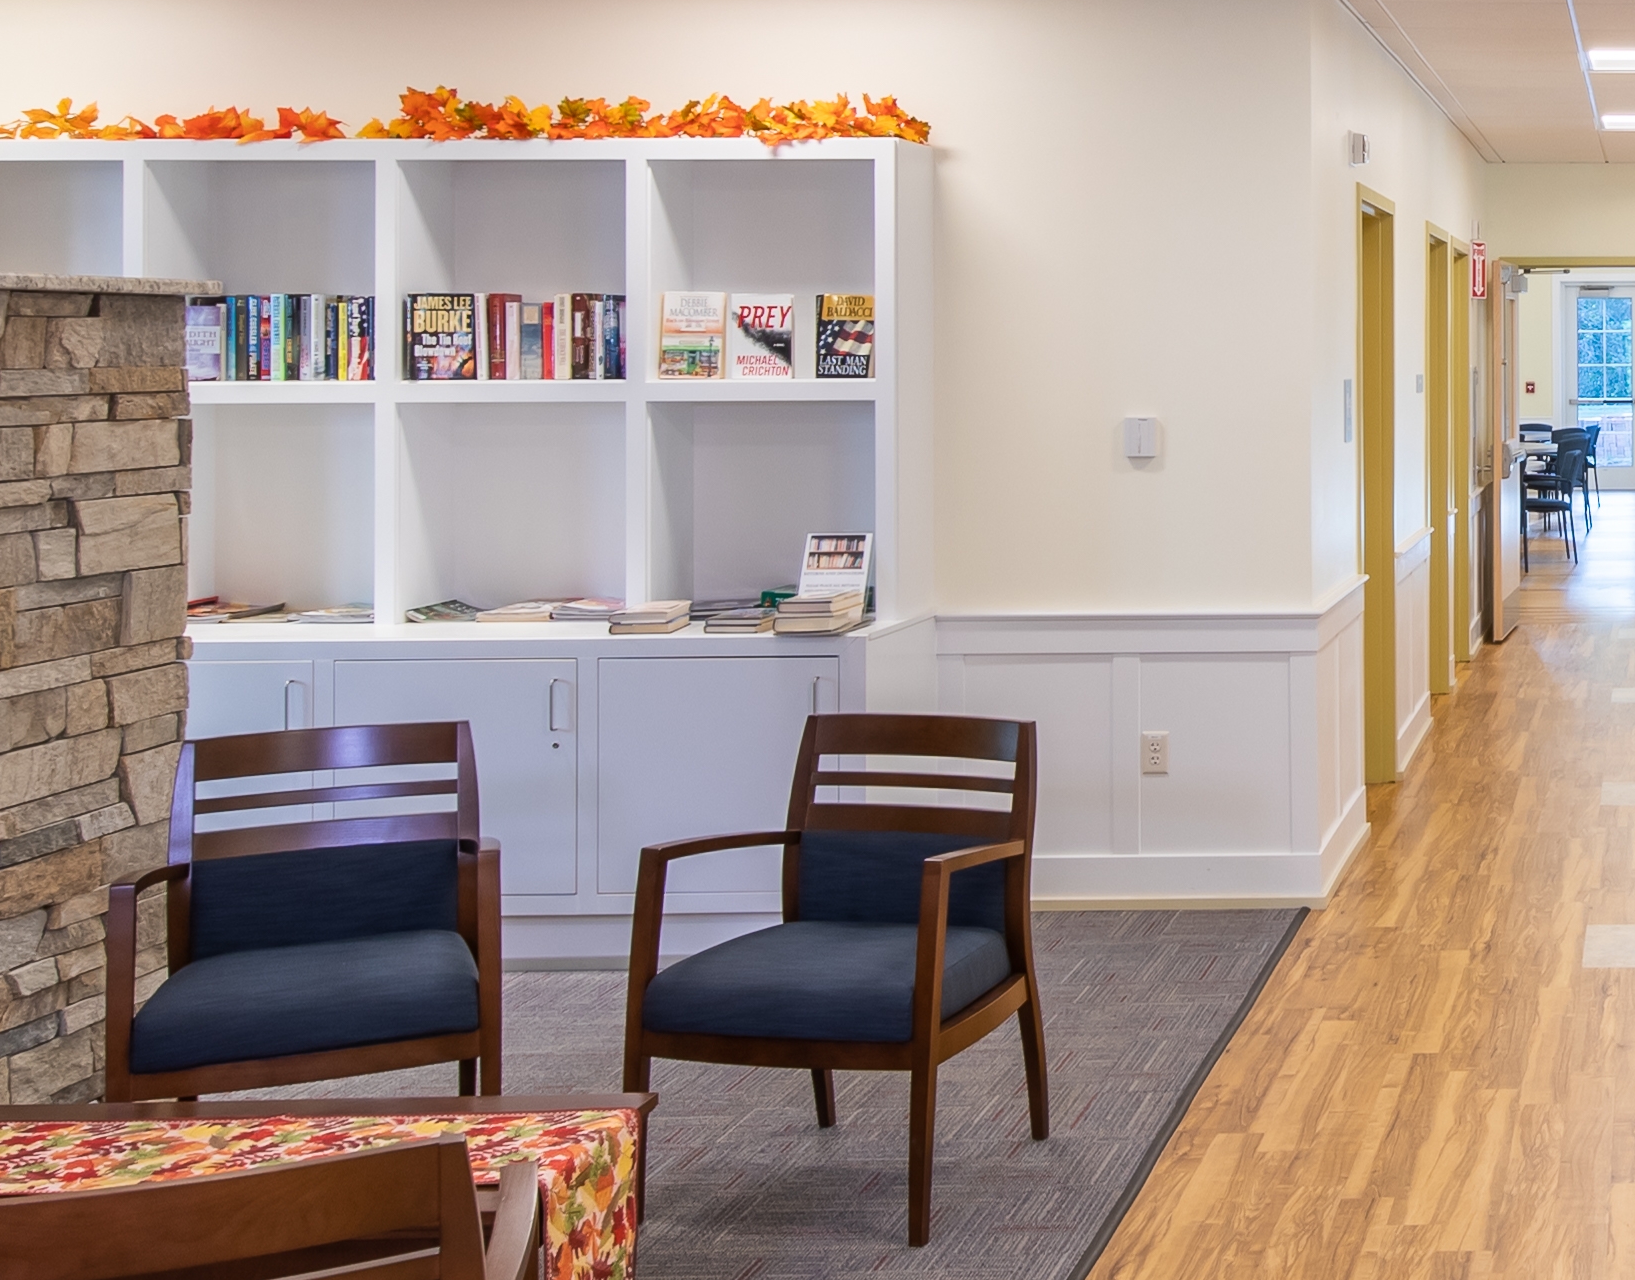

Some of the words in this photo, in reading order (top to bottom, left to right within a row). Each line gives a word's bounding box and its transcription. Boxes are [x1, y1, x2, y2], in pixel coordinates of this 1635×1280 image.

[413, 296, 452, 310] JAMES
[453, 296, 472, 310] LEE
[680, 298, 708, 308] DEBBIE
[836, 296, 865, 307] DAVID
[669, 308, 718, 317] MACOMBER
[737, 306, 792, 329] PREY
[826, 307, 873, 318] BALDACCI
[413, 311, 472, 333] BURKE
[249, 317, 257, 345] CUSSLER
[421, 334, 437, 345] The
[414, 345, 456, 357] Blowdown
[736, 355, 779, 366] MICHAEL
[819, 356, 842, 366] LAST
[845, 355, 867, 366] MAN
[742, 366, 790, 376] CRICHTON
[818, 365, 867, 376] STANDING
